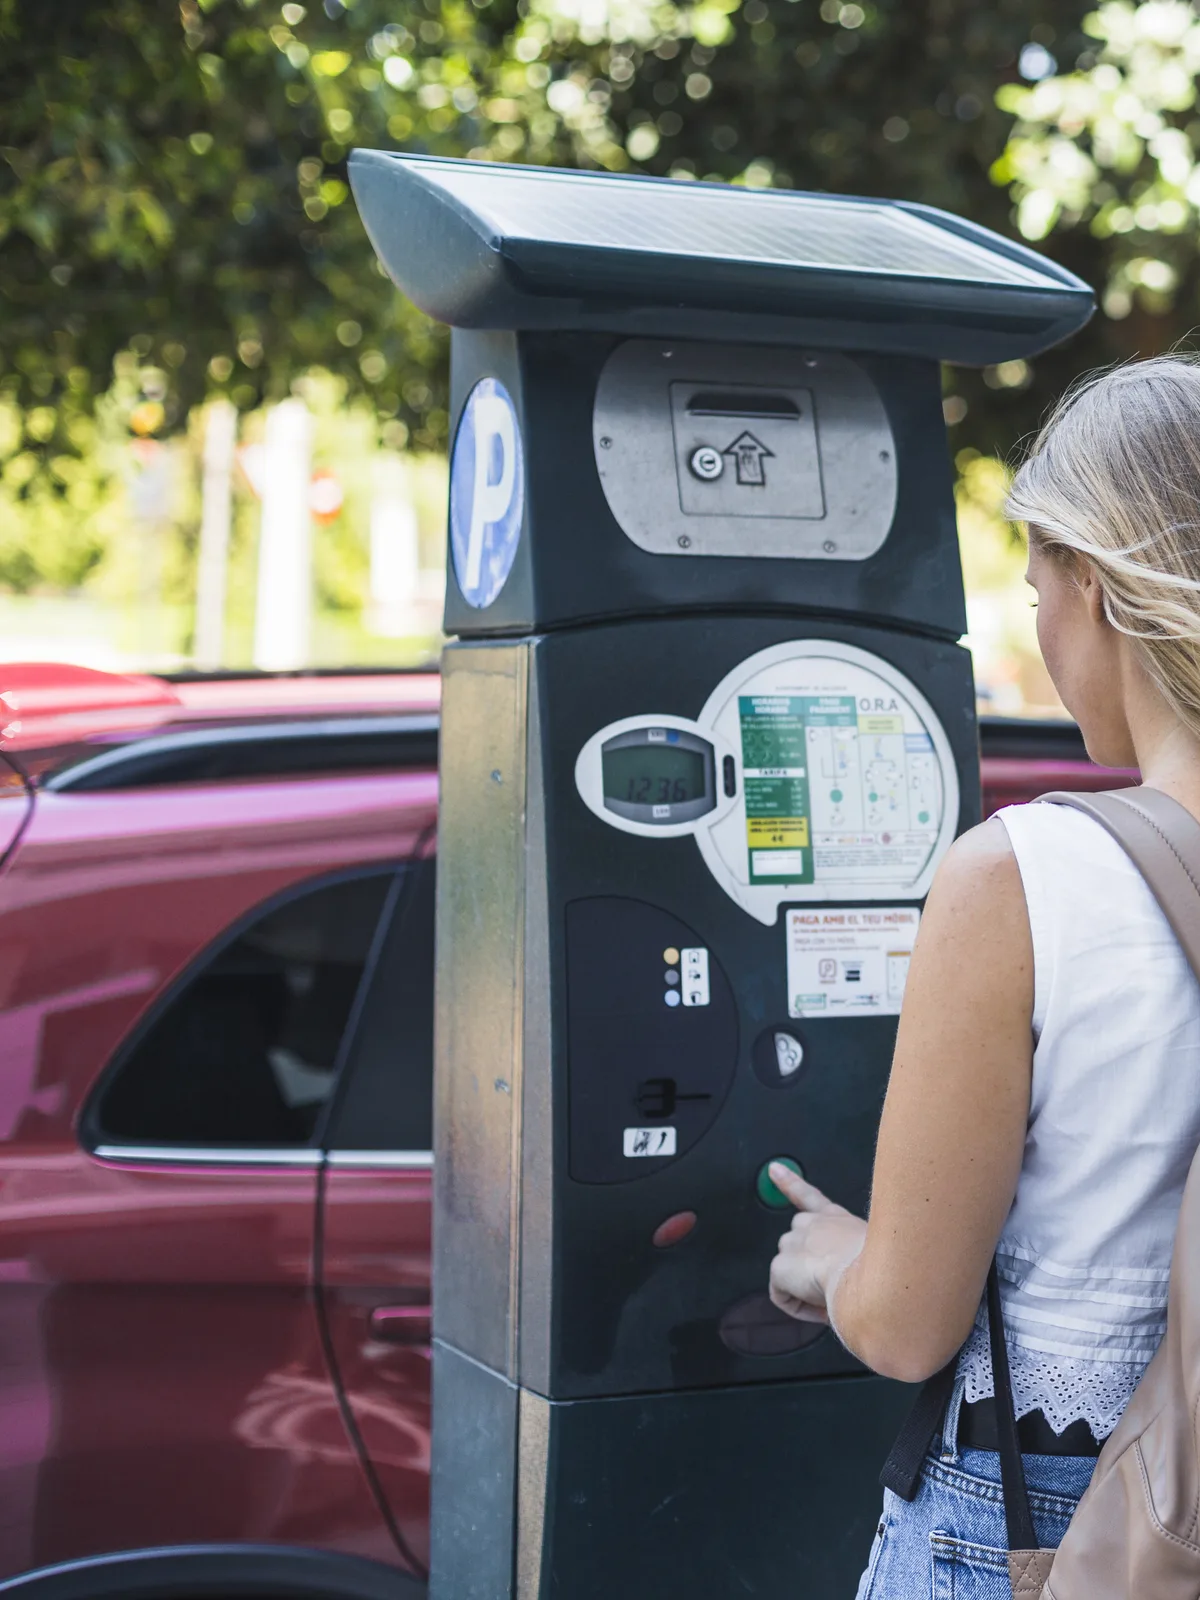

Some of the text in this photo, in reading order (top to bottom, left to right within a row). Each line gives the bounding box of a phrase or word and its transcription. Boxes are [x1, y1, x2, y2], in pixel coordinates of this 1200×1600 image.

[464, 395, 516, 589] P
[792, 915, 820, 925] PAGA
[822, 915, 845, 925] AMB
[847, 915, 859, 925] EL
[862, 914, 881, 924] TEU
